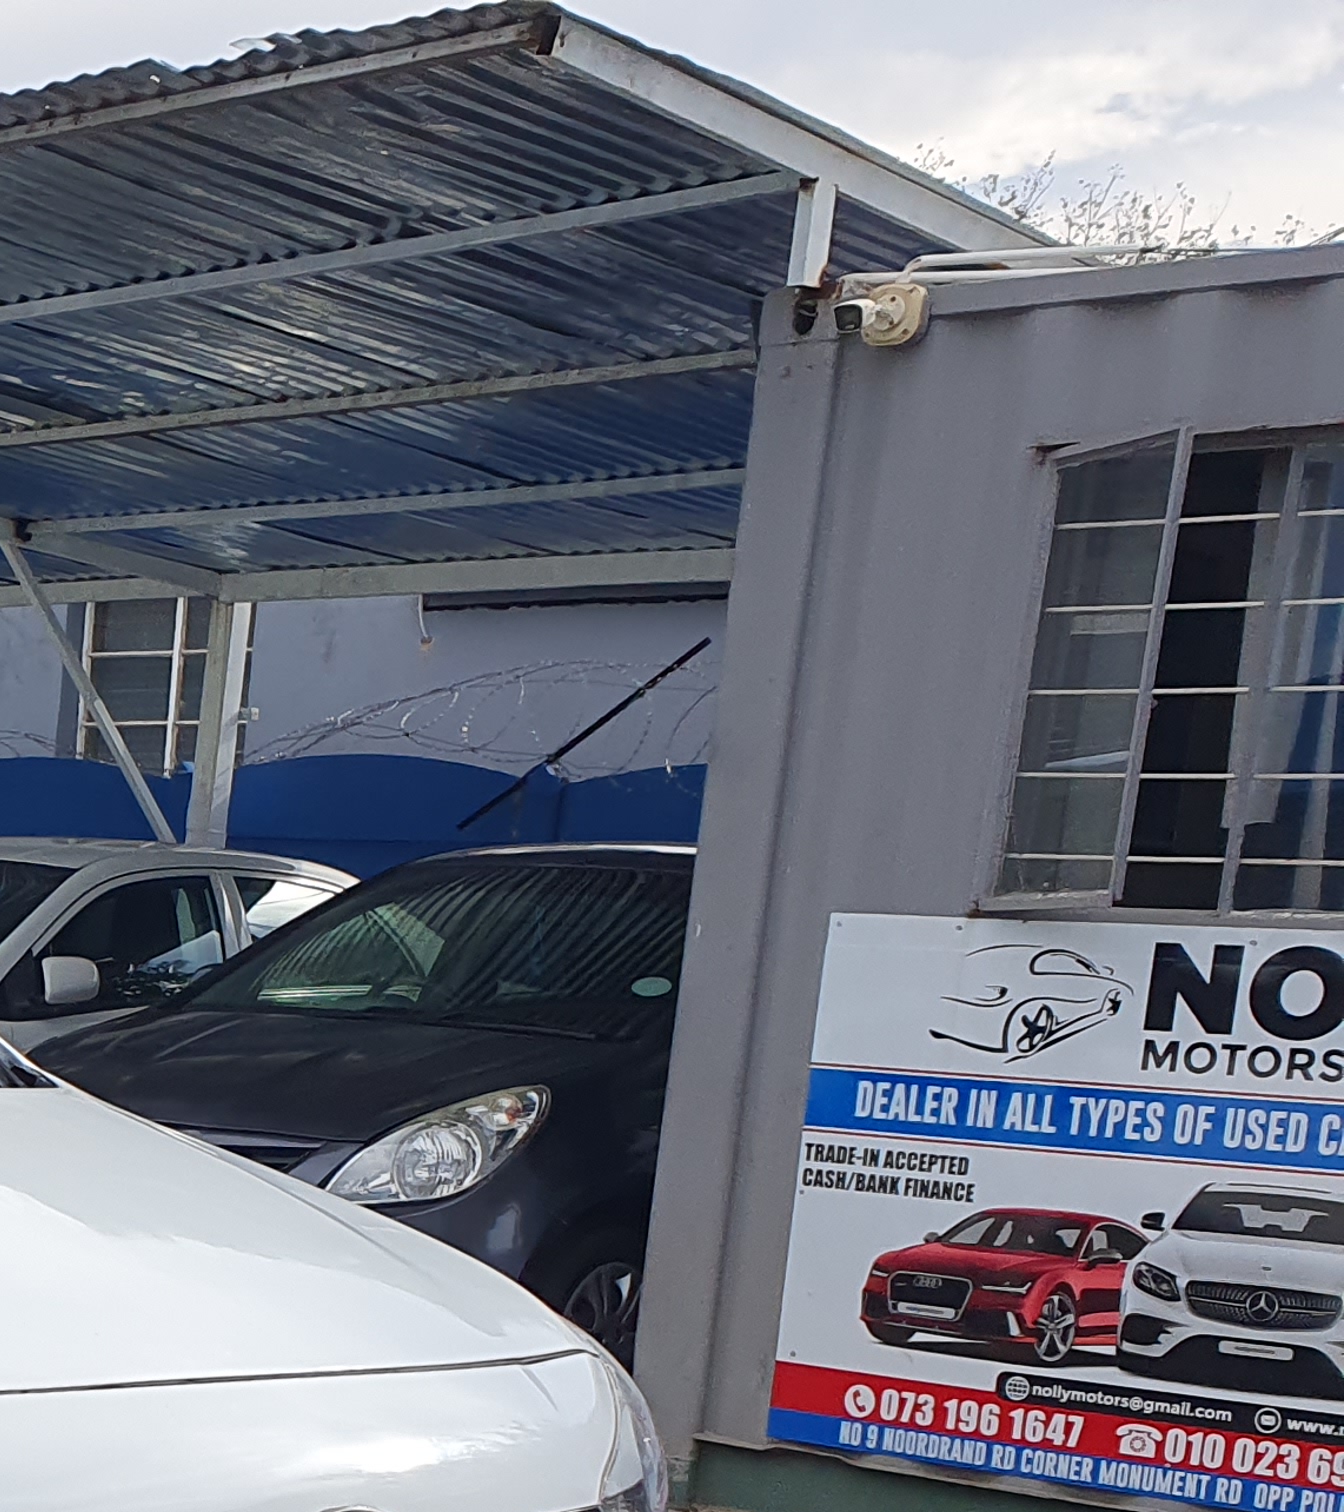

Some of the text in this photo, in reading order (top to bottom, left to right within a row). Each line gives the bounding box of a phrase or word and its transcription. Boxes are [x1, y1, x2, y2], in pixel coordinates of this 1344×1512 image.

[1140, 1038, 1344, 1083] MOTORS
[854, 1080, 1344, 1156] DEALER IN ALL TYPES OF USED C
[804, 1142, 970, 1177] TRADE-IN ACCEPTED
[802, 1167, 976, 1203] CASH/BANK FINANCE
[880, 1388, 1085, 1448] 073 196 1647
[1031, 1384, 1233, 1423] nollymotors@gmail.com
[839, 1420, 863, 1447] NO
[865, 1425, 878, 1450] 9
[882, 1427, 987, 1467] NOORDRAND
[990, 1444, 1016, 1471] RD
[1020, 1449, 1094, 1482] CORNER
[1098, 1459, 1212, 1501] MONUMENT
[1214, 1477, 1244, 1506] RD
[1253, 1483, 1295, 1512] OPP
[1164, 1427, 1226, 1470] 010
[1232, 1437, 1301, 1480] 023
